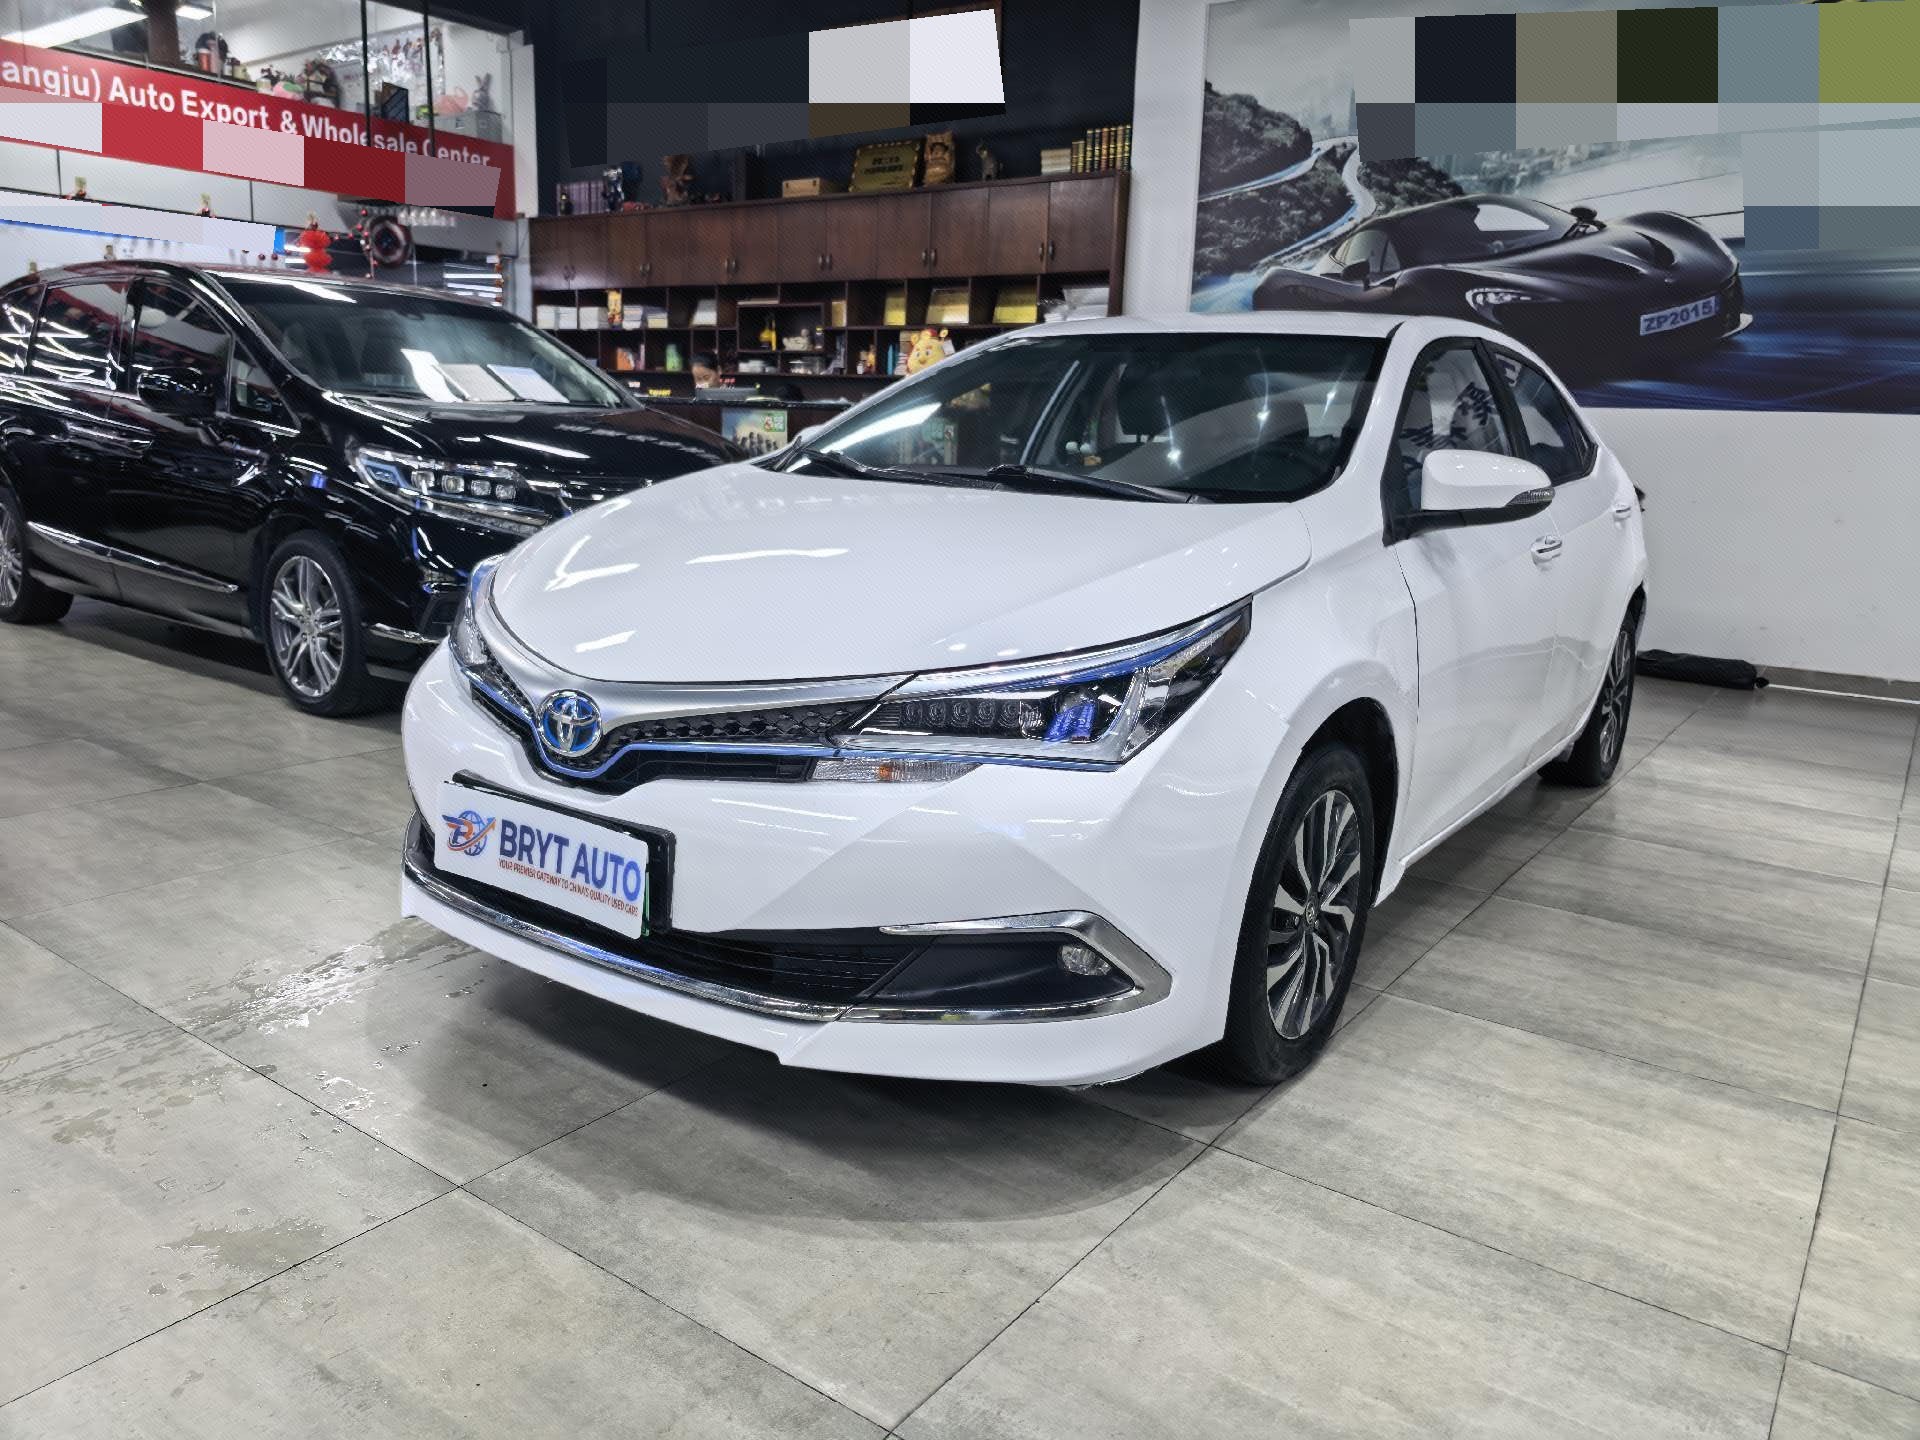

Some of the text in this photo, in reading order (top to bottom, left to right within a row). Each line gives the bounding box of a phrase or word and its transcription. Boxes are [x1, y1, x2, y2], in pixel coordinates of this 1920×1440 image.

[108, 76, 175, 113] Auto
[180, 89, 270, 130] Export
[280, 110, 298, 135] &
[1644, 300, 1713, 332] ZP2015
[499, 818, 641, 902] BRYT AUTO
